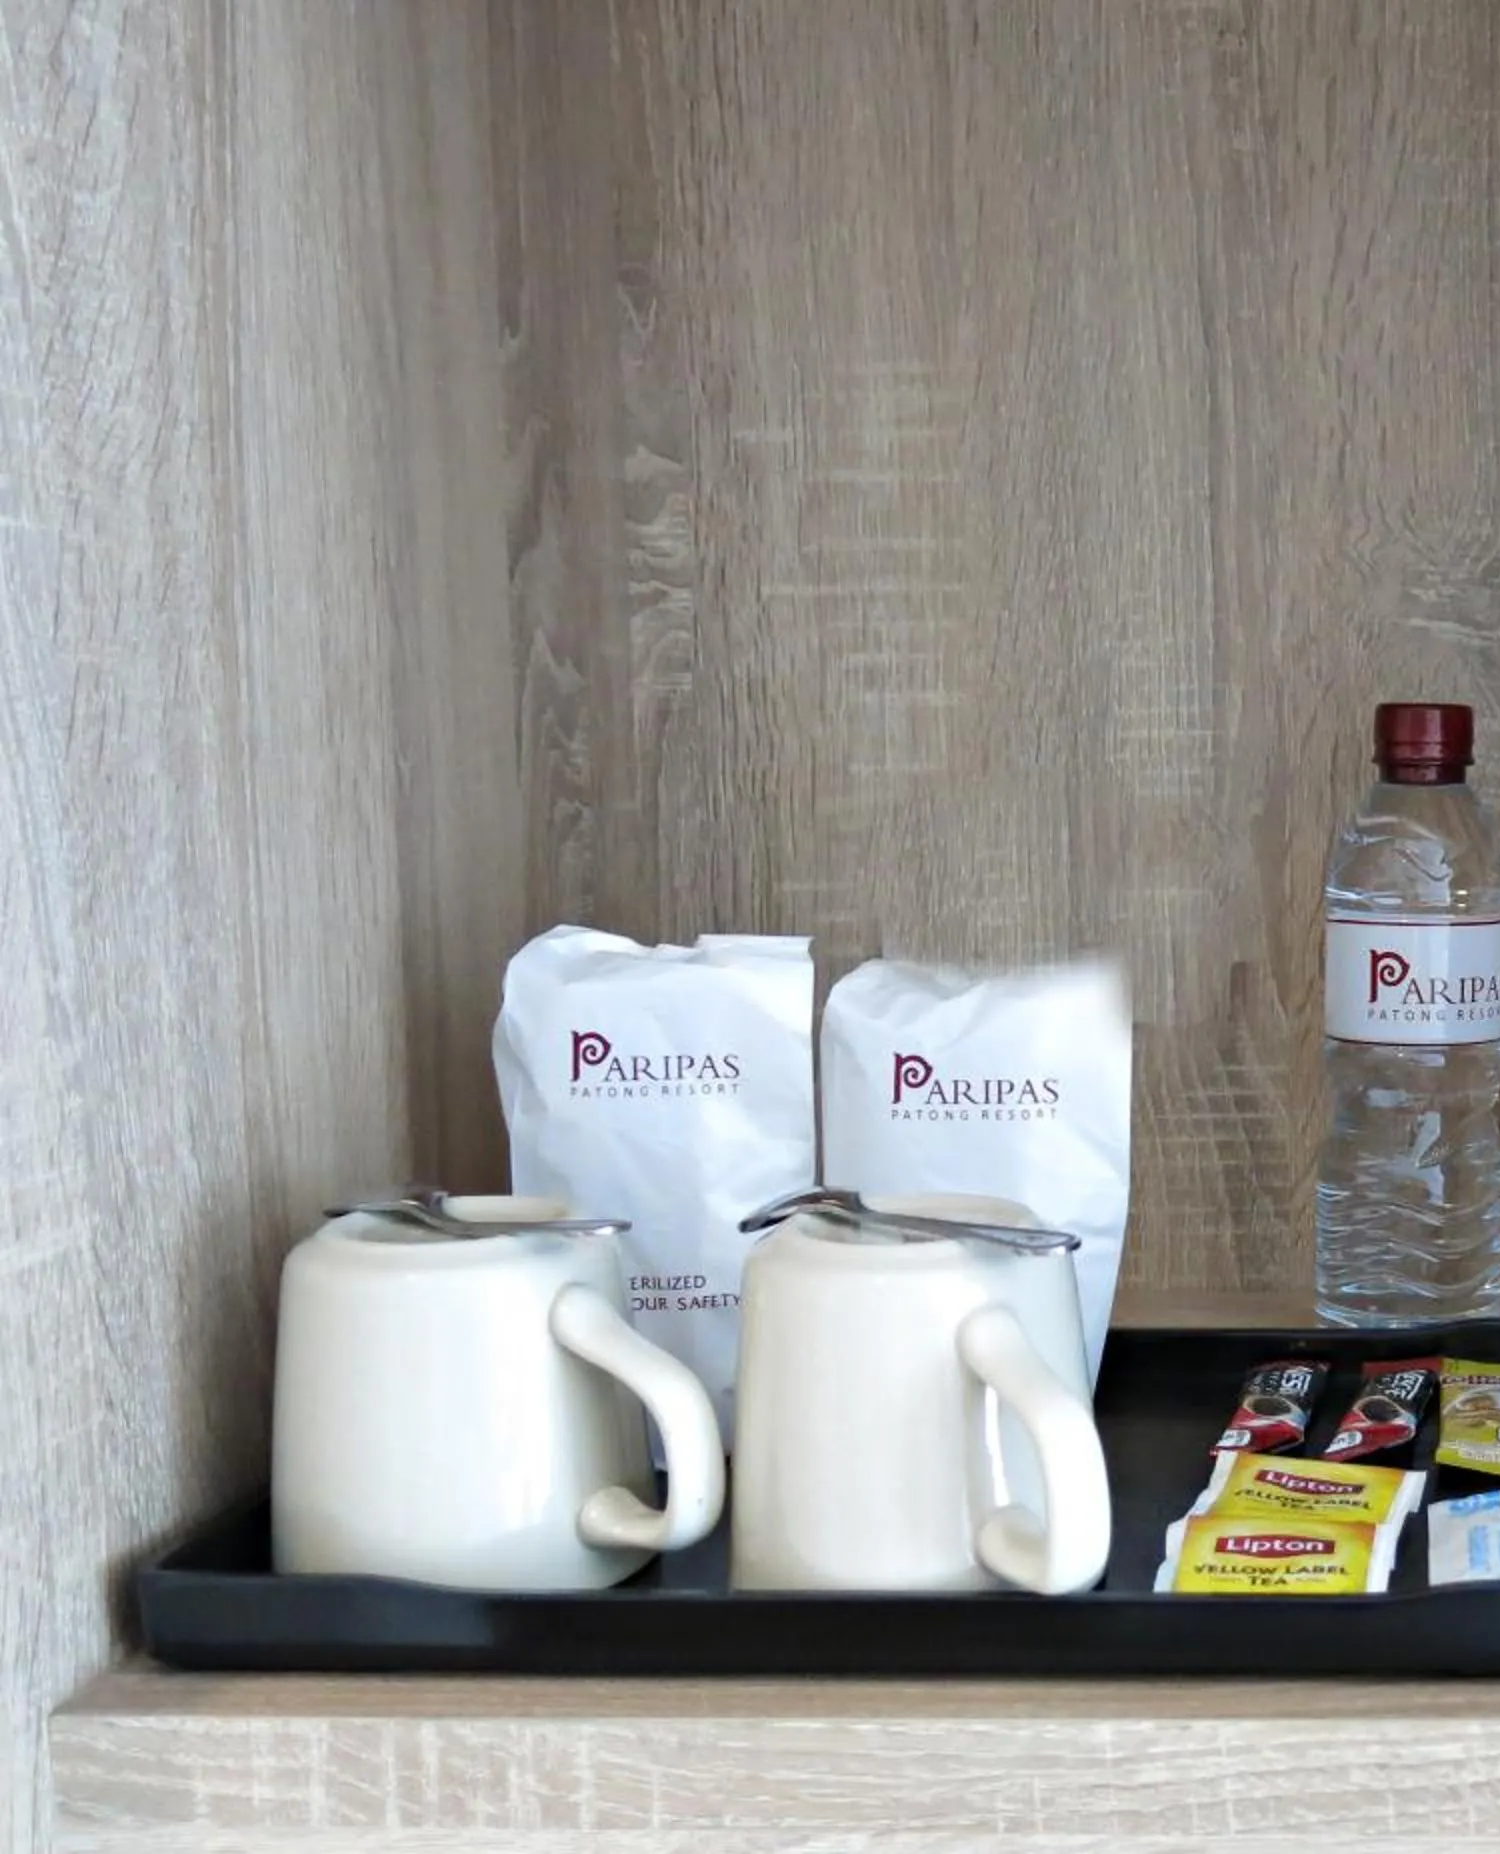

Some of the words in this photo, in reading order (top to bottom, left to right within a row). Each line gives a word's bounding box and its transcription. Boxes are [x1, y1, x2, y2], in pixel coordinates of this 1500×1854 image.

[1367, 1008, 1448, 1021] PATONG
[571, 1030, 740, 1082] PARIPAS
[892, 1052, 1059, 1105] PARIPAS
[570, 1086, 650, 1098] PATONG
[661, 1083, 740, 1096] RESORT
[891, 1109, 969, 1121] PATONG
[981, 1107, 1057, 1121] RESORT
[629, 1275, 707, 1291] ERILIZED
[631, 1297, 668, 1311] OUR
[677, 1293, 741, 1311] SAFETY
[1264, 1471, 1354, 1494] Lipton
[1234, 1488, 1307, 1504] YELLOW
[1313, 1497, 1371, 1510] LABEL
[1280, 1501, 1315, 1511] TEA
[1225, 1537, 1325, 1553] Lipton
[1194, 1565, 1278, 1576] YELLOW
[1284, 1565, 1349, 1576] LABEL
[1249, 1576, 1288, 1586] TEA
